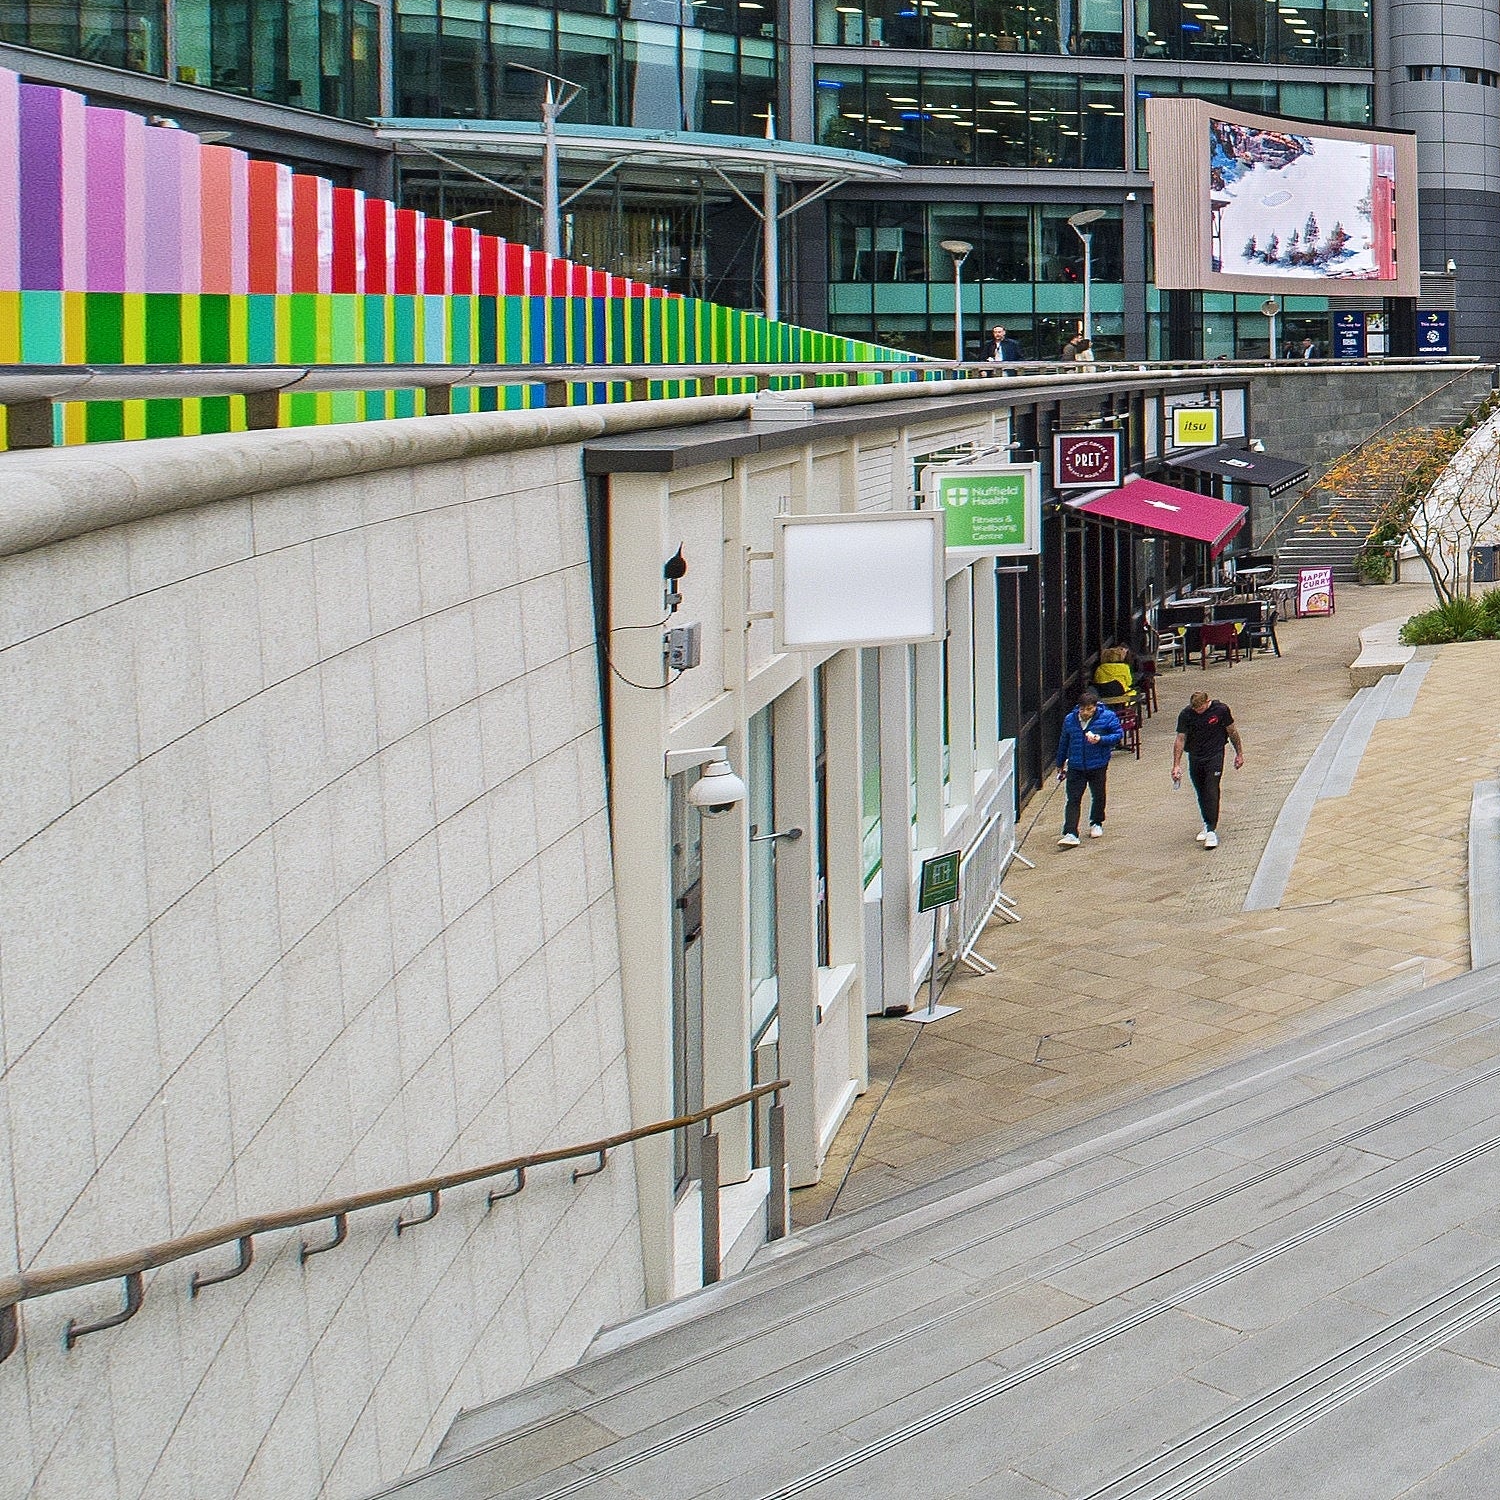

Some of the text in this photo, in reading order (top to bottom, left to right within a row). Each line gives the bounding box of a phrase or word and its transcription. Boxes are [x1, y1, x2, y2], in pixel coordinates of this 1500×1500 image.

[1184, 421, 1207, 431] itsu
[1075, 452, 1101, 467] PRET
[972, 485, 1019, 497] Nuffield
[972, 496, 1009, 506] Health
[1302, 577, 1330, 589] CURRY
